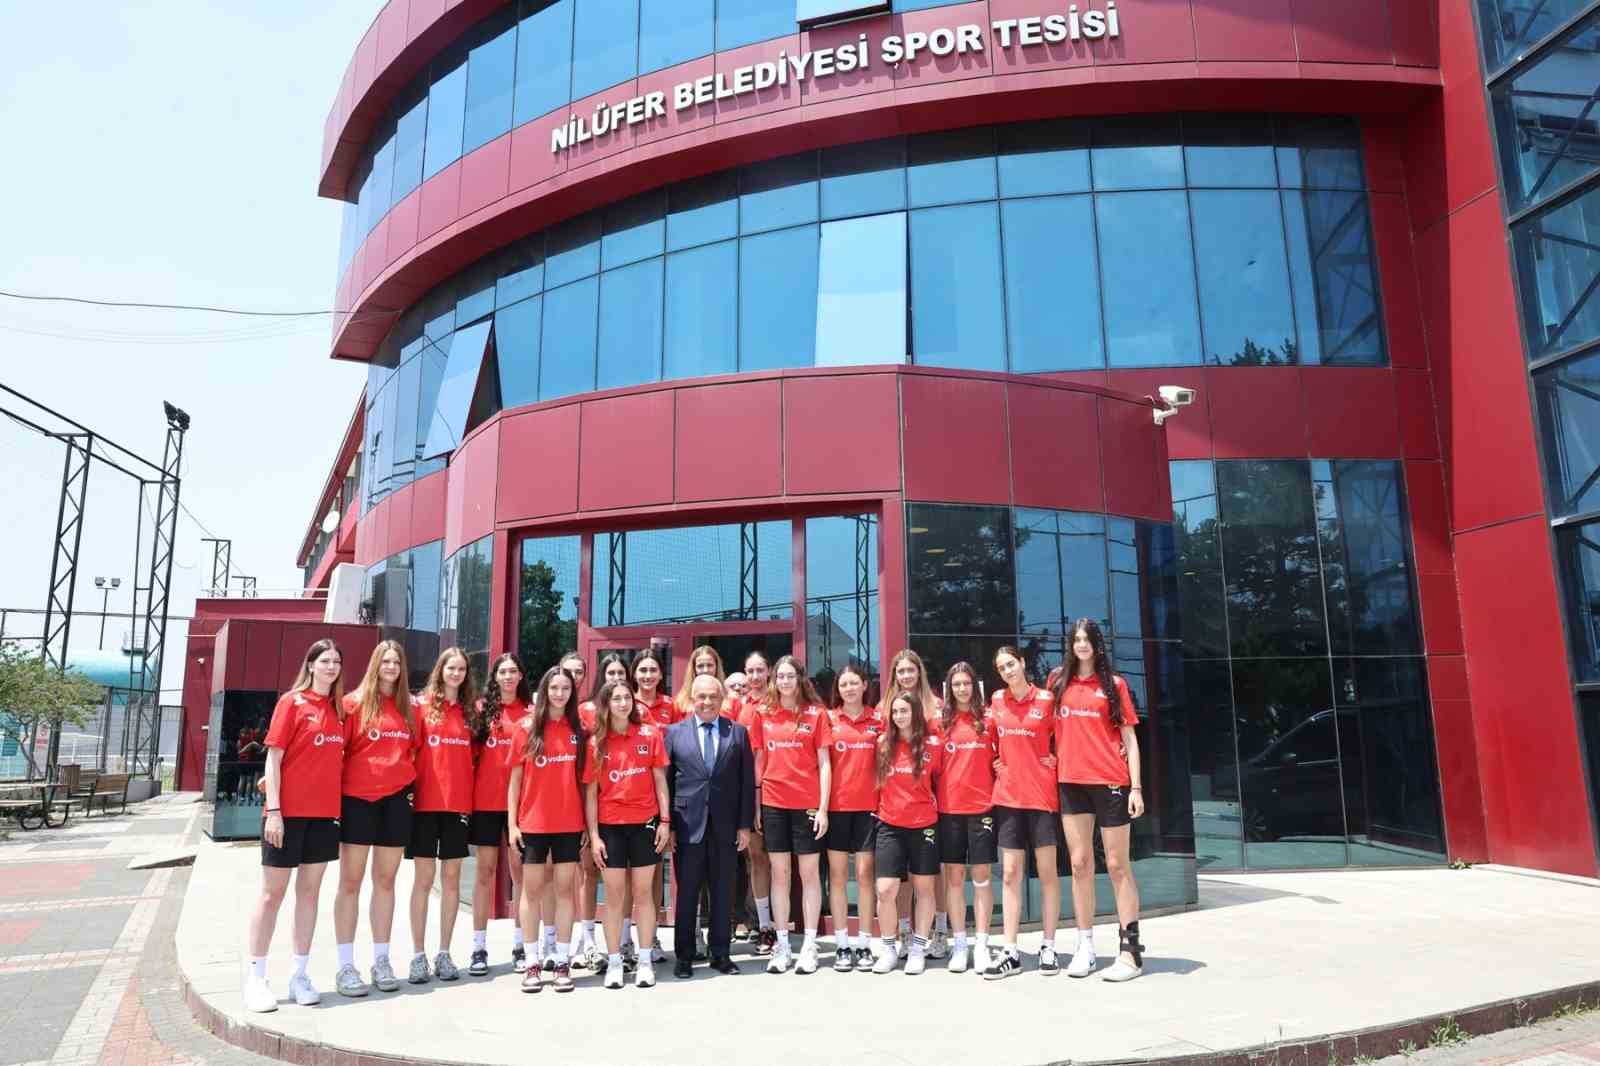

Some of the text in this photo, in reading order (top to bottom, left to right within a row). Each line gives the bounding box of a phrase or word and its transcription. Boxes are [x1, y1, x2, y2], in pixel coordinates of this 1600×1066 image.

[551, 91, 667, 153] NİLÜFER
[673, 33, 869, 111] BELEDİYESİ
[992, 1, 1119, 48] TESİSİ
[1005, 727, 1036, 738] vodafone
